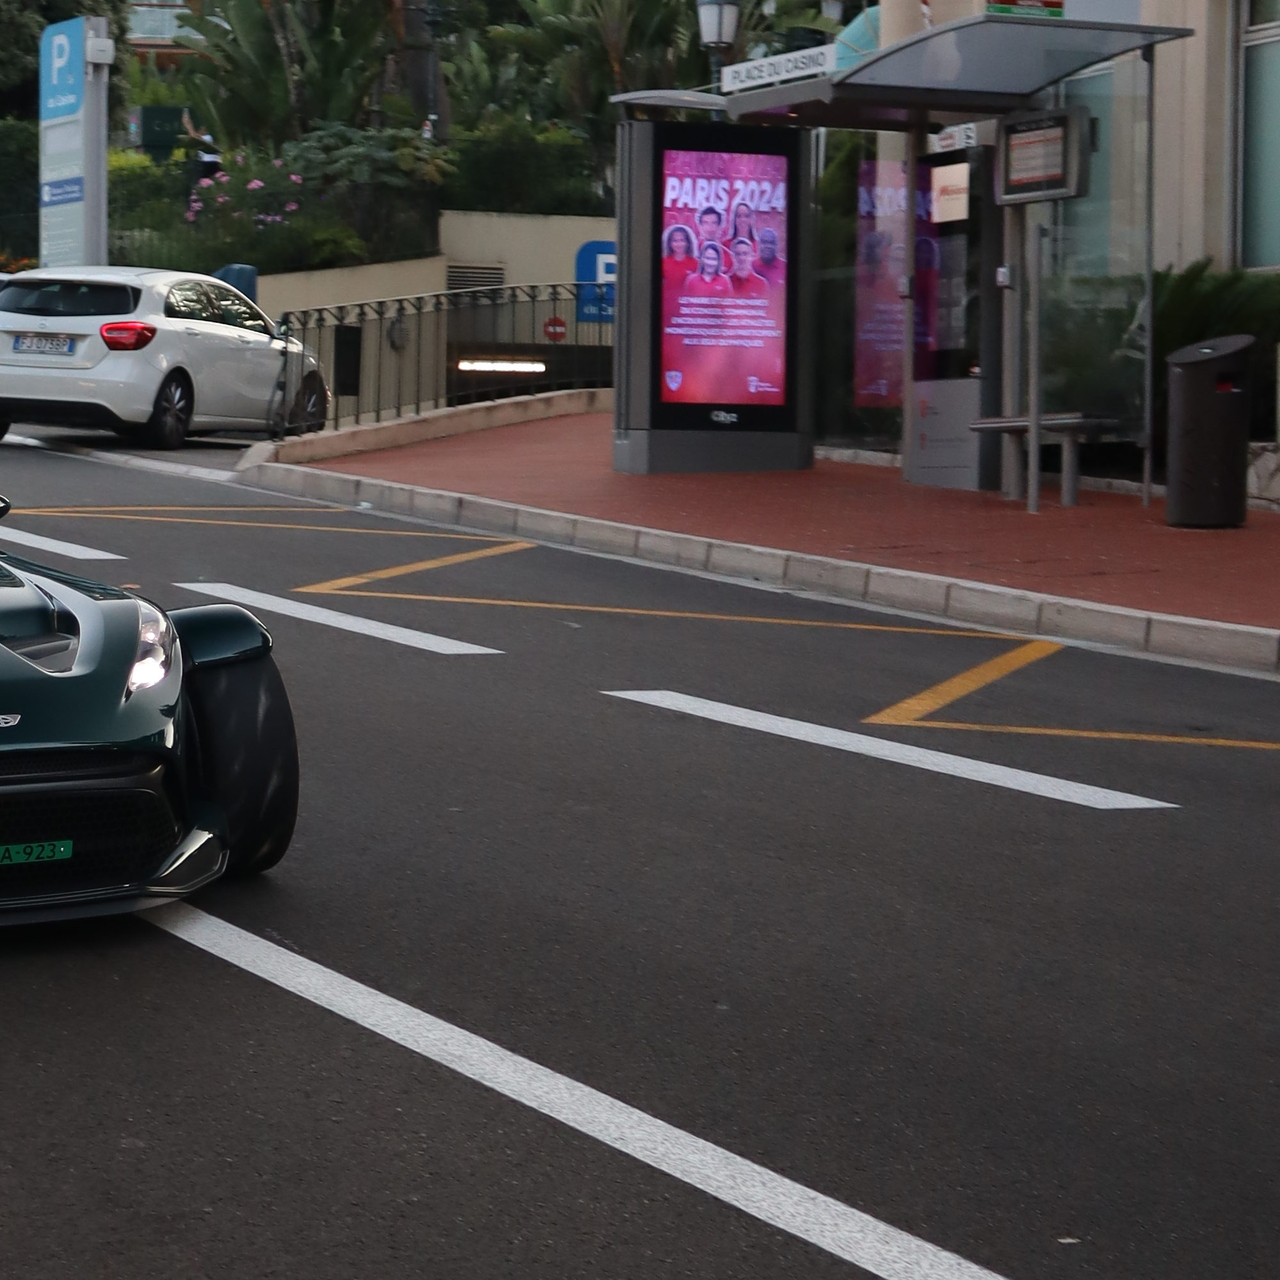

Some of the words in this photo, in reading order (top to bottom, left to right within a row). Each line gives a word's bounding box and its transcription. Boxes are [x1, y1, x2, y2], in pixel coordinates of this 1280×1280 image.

[51, 33, 70, 85] P
[732, 64, 765, 84] PLACE
[767, 61, 782, 77] DU
[785, 51, 826, 73] CASINO
[663, 176, 730, 211] PARIS
[732, 179, 787, 213] 2024
